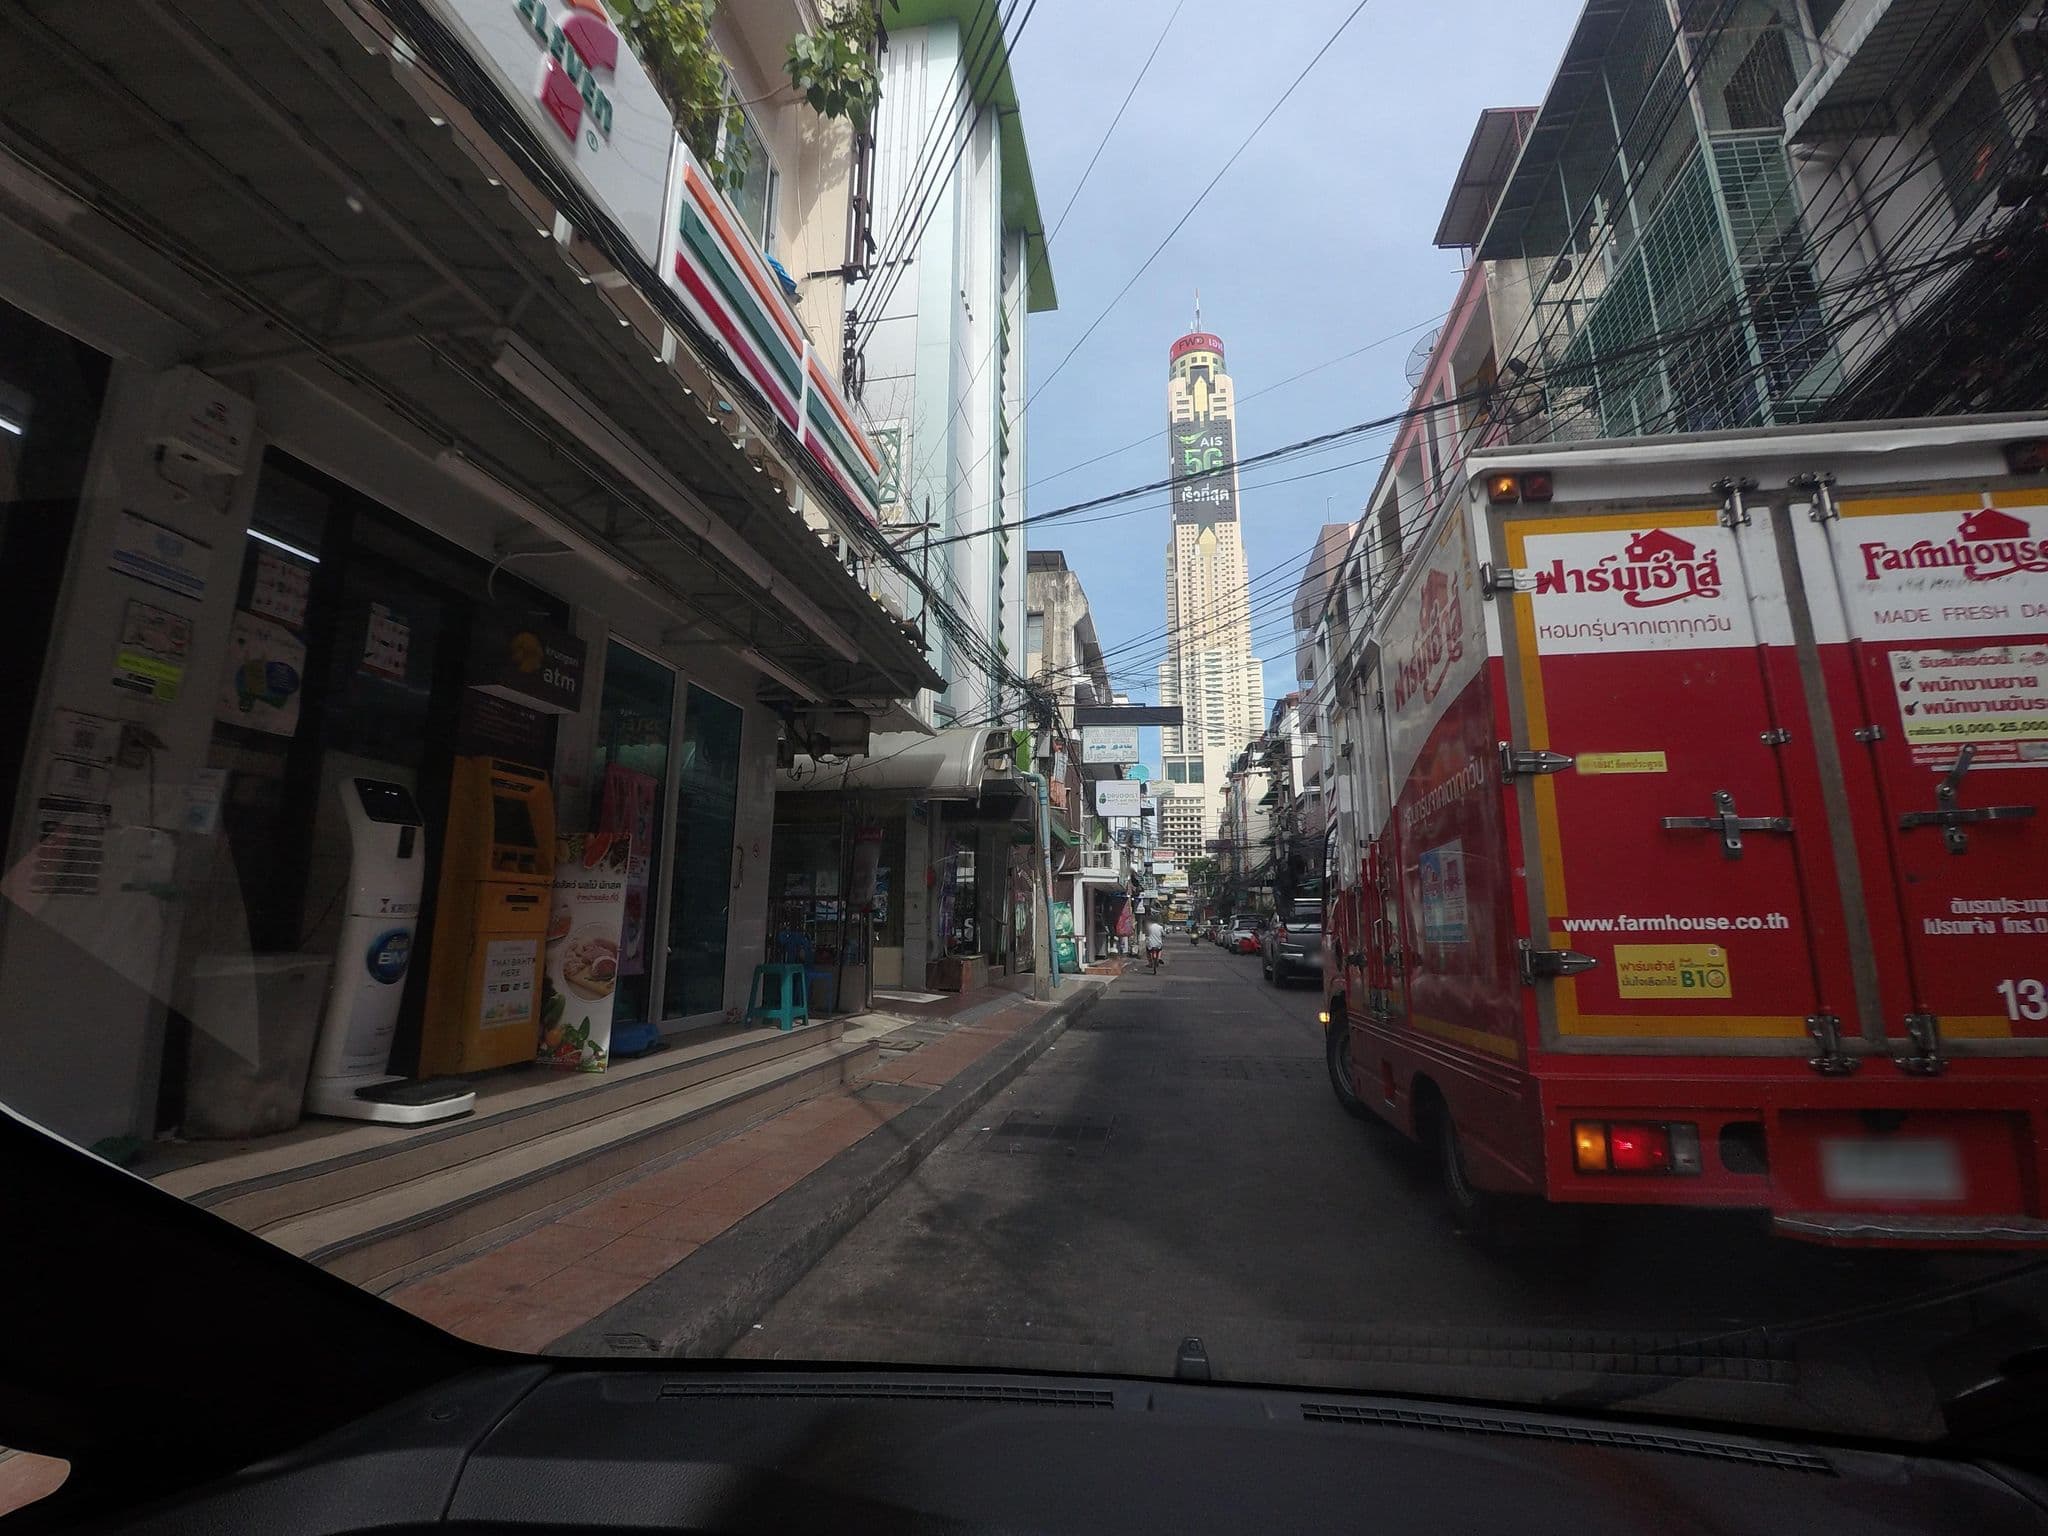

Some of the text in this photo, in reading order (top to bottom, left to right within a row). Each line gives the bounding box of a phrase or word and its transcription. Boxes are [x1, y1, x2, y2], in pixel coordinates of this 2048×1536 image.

[1179, 336, 1204, 350] FWD
[1200, 436, 1224, 447] AIS
[1183, 447, 1224, 476] 5G
[1182, 482, 1230, 506] เร็วที่สุด
[1535, 548, 1722, 607] ฟาร์มเฮ้าส์
[1873, 608, 1931, 625] MADE
[1942, 605, 2009, 622] FRESH
[1539, 614, 1732, 641] หอมกรุ่นจากเตาทุกวัน
[543, 667, 576, 693] atm
[1562, 913, 1790, 932] www.farmhouse.co.th
